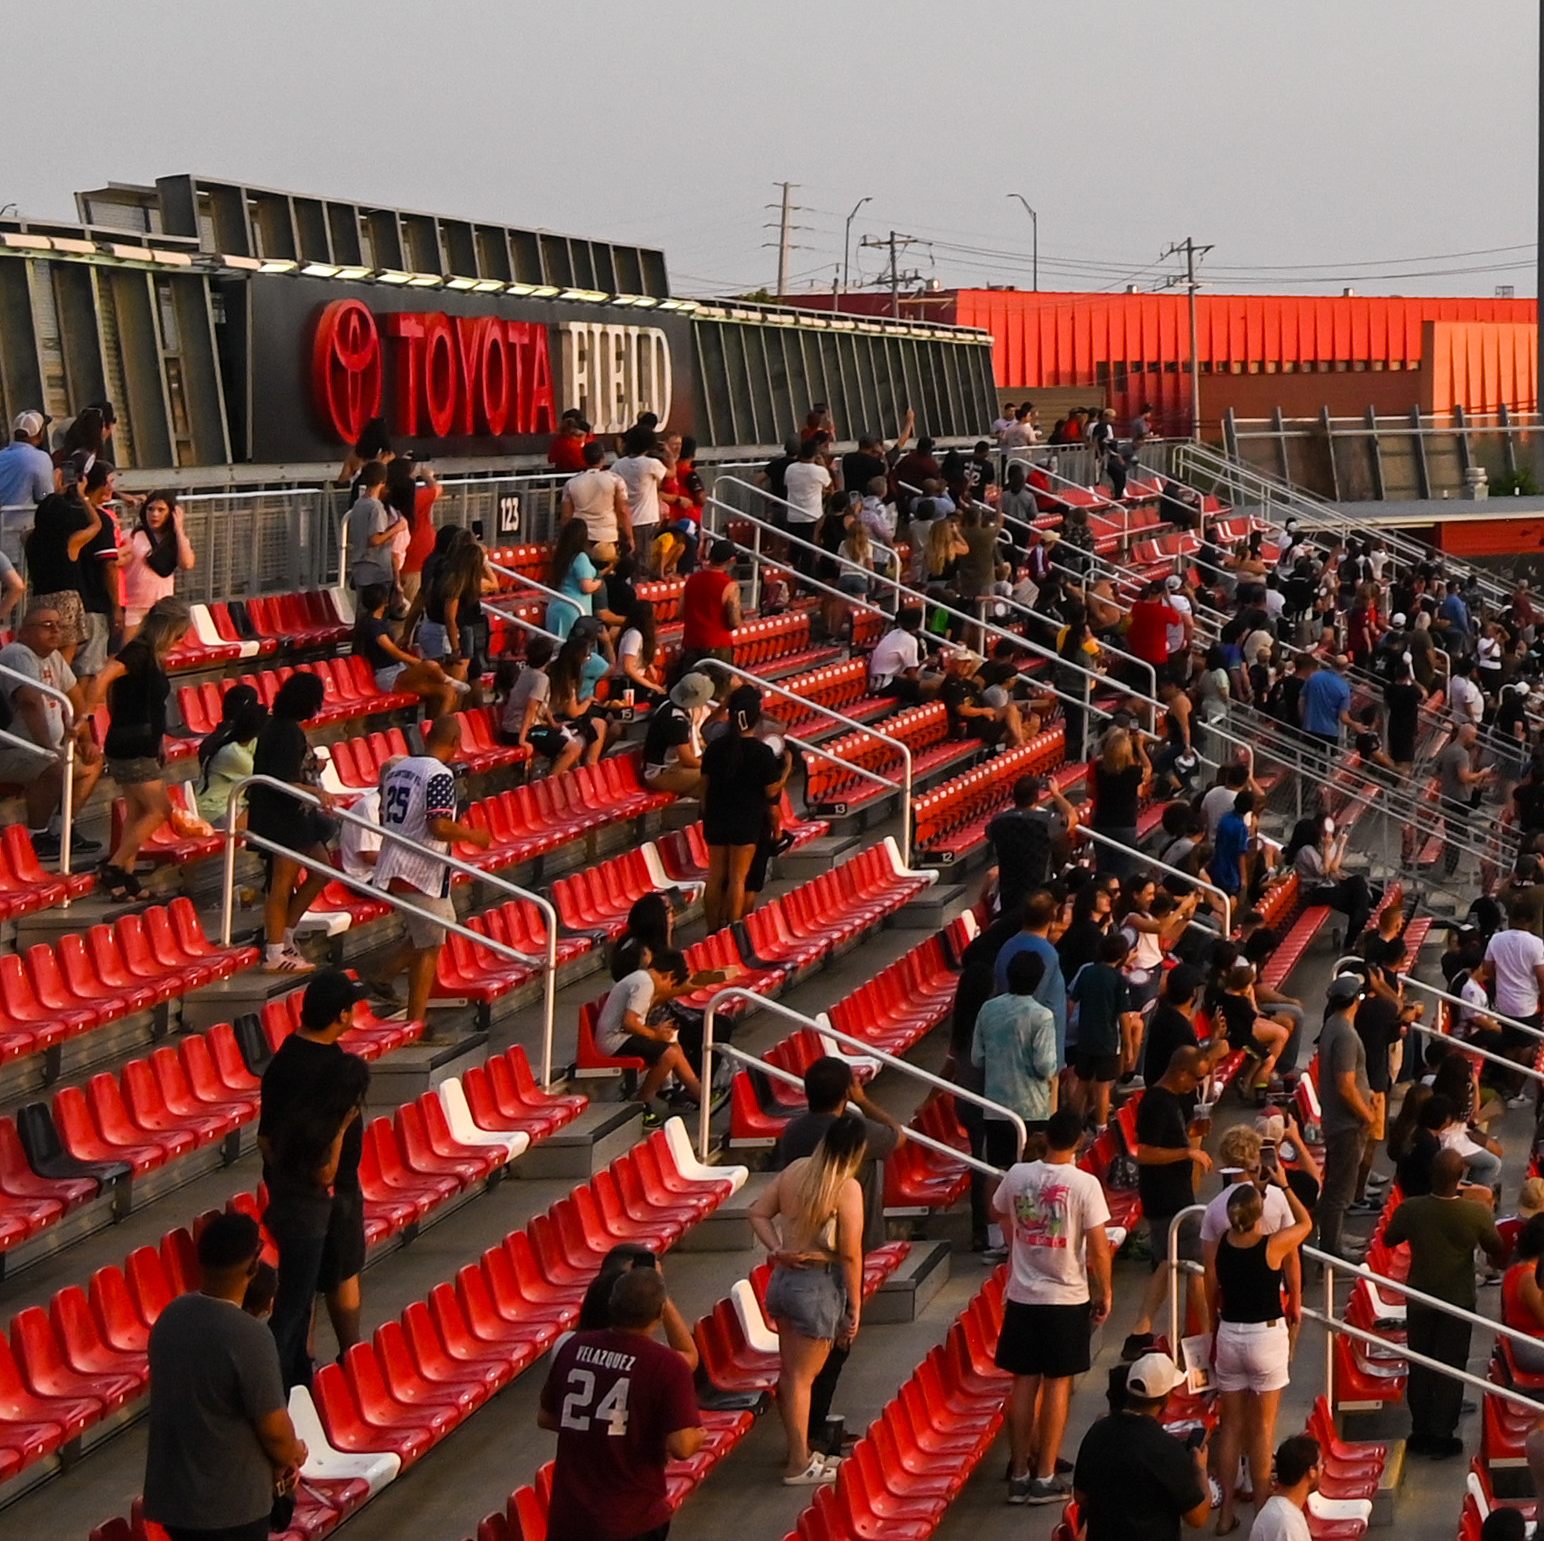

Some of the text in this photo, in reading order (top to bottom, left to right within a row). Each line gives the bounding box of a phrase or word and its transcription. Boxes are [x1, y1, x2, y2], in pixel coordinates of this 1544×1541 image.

[386, 311, 673, 437] TOYOTA FIELD
[500, 497, 520, 532] 123
[386, 785, 411, 824] 25
[576, 1345, 637, 1372] VELAZQUEZ
[561, 1368, 631, 1436] 24
